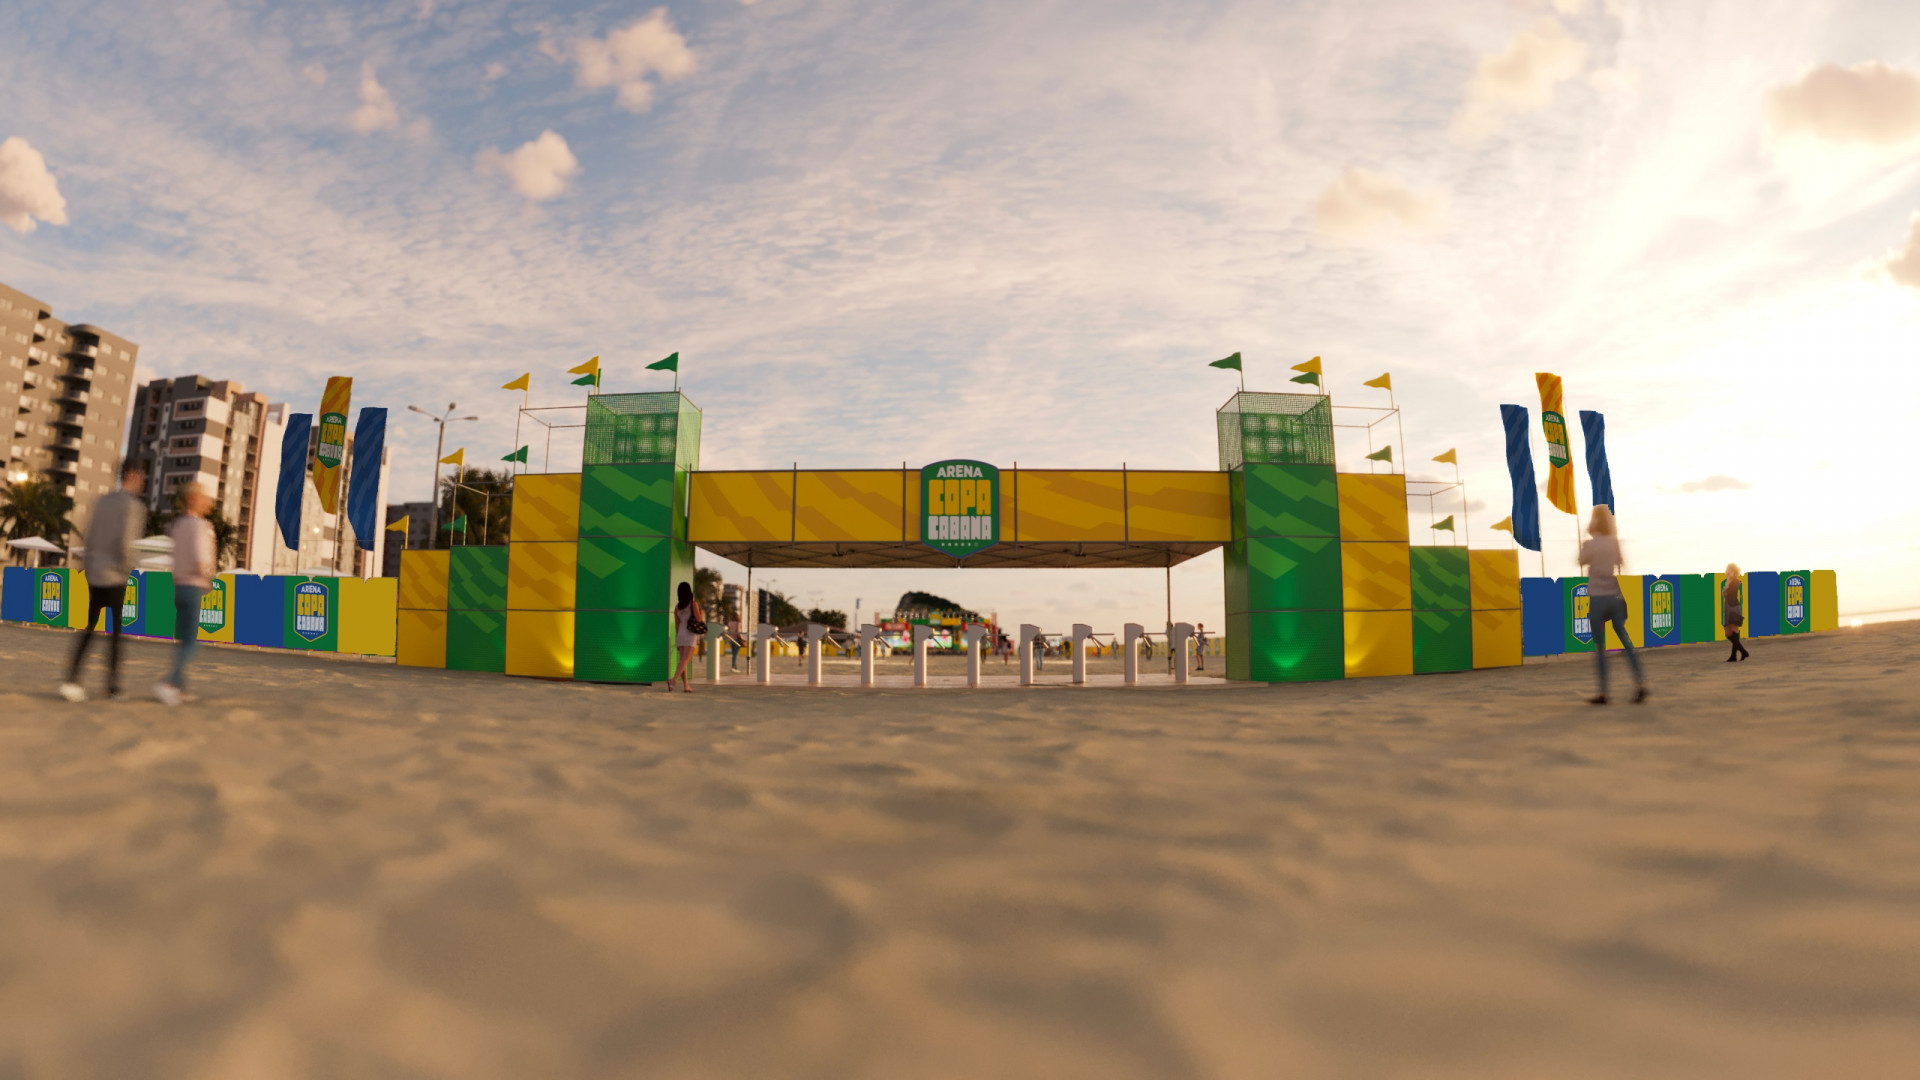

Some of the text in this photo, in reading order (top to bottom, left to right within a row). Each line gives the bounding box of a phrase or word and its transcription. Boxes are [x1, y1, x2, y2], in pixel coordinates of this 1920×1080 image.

[936, 465, 983, 478] ARENA
[928, 480, 991, 515] COPA
[928, 516, 992, 540] CABANA
[301, 585, 321, 593] ARENA
[297, 594, 325, 616] COPA
